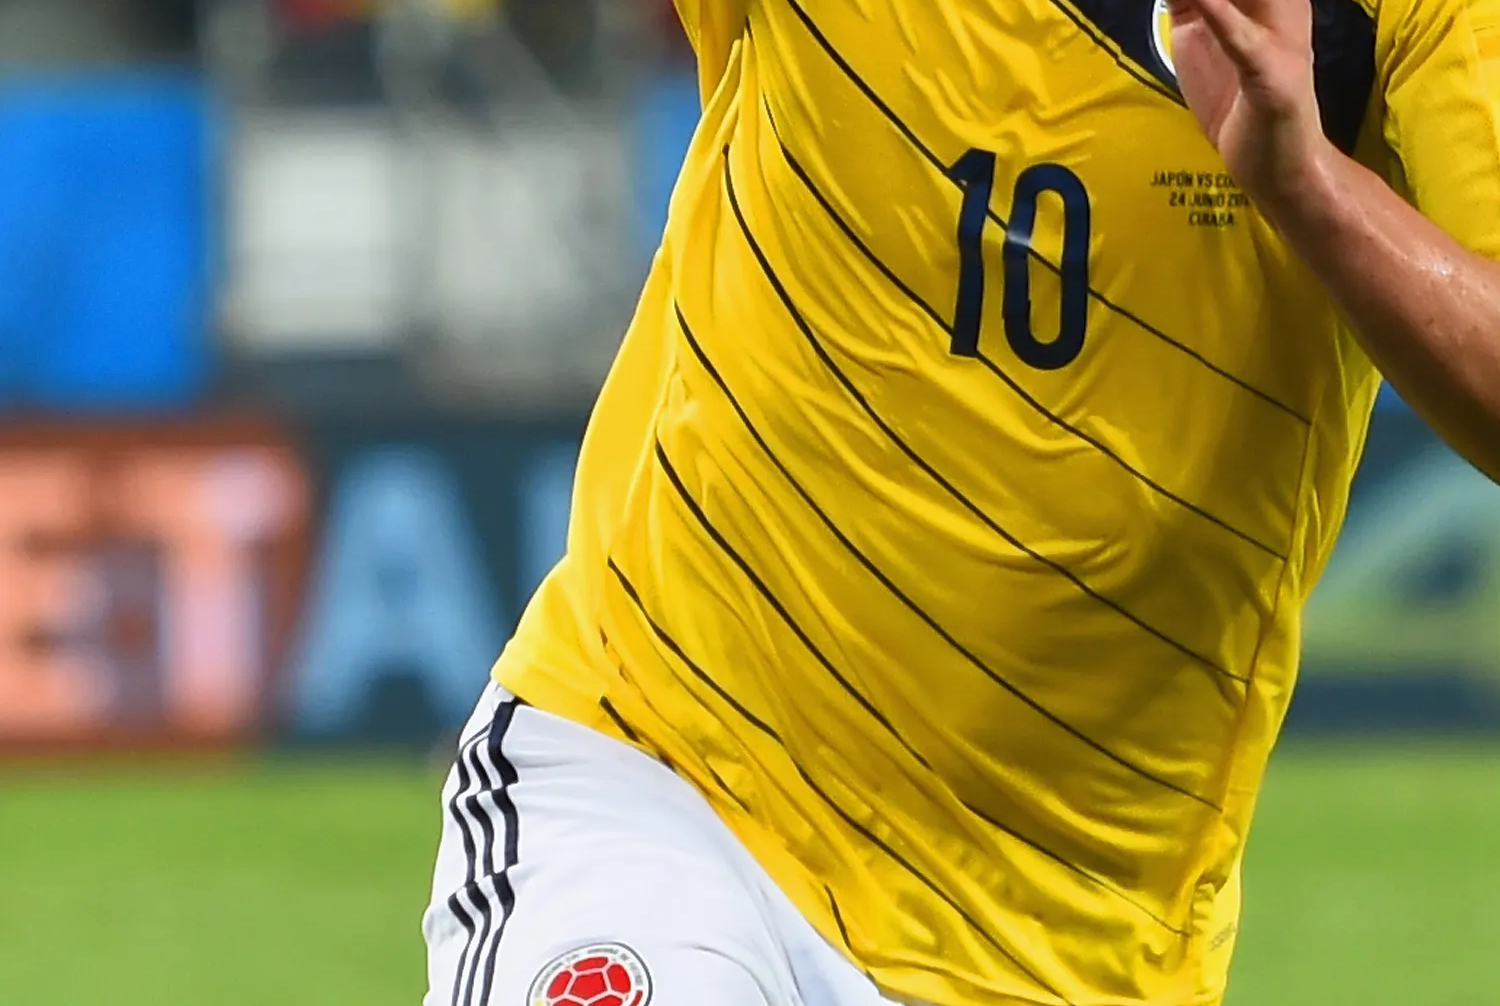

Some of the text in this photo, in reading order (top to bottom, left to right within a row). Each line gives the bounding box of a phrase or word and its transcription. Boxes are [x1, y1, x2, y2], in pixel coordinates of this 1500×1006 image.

[1196, 172, 1213, 188] VS
[1169, 192, 1186, 207] 24
[950, 147, 1090, 371] 10
